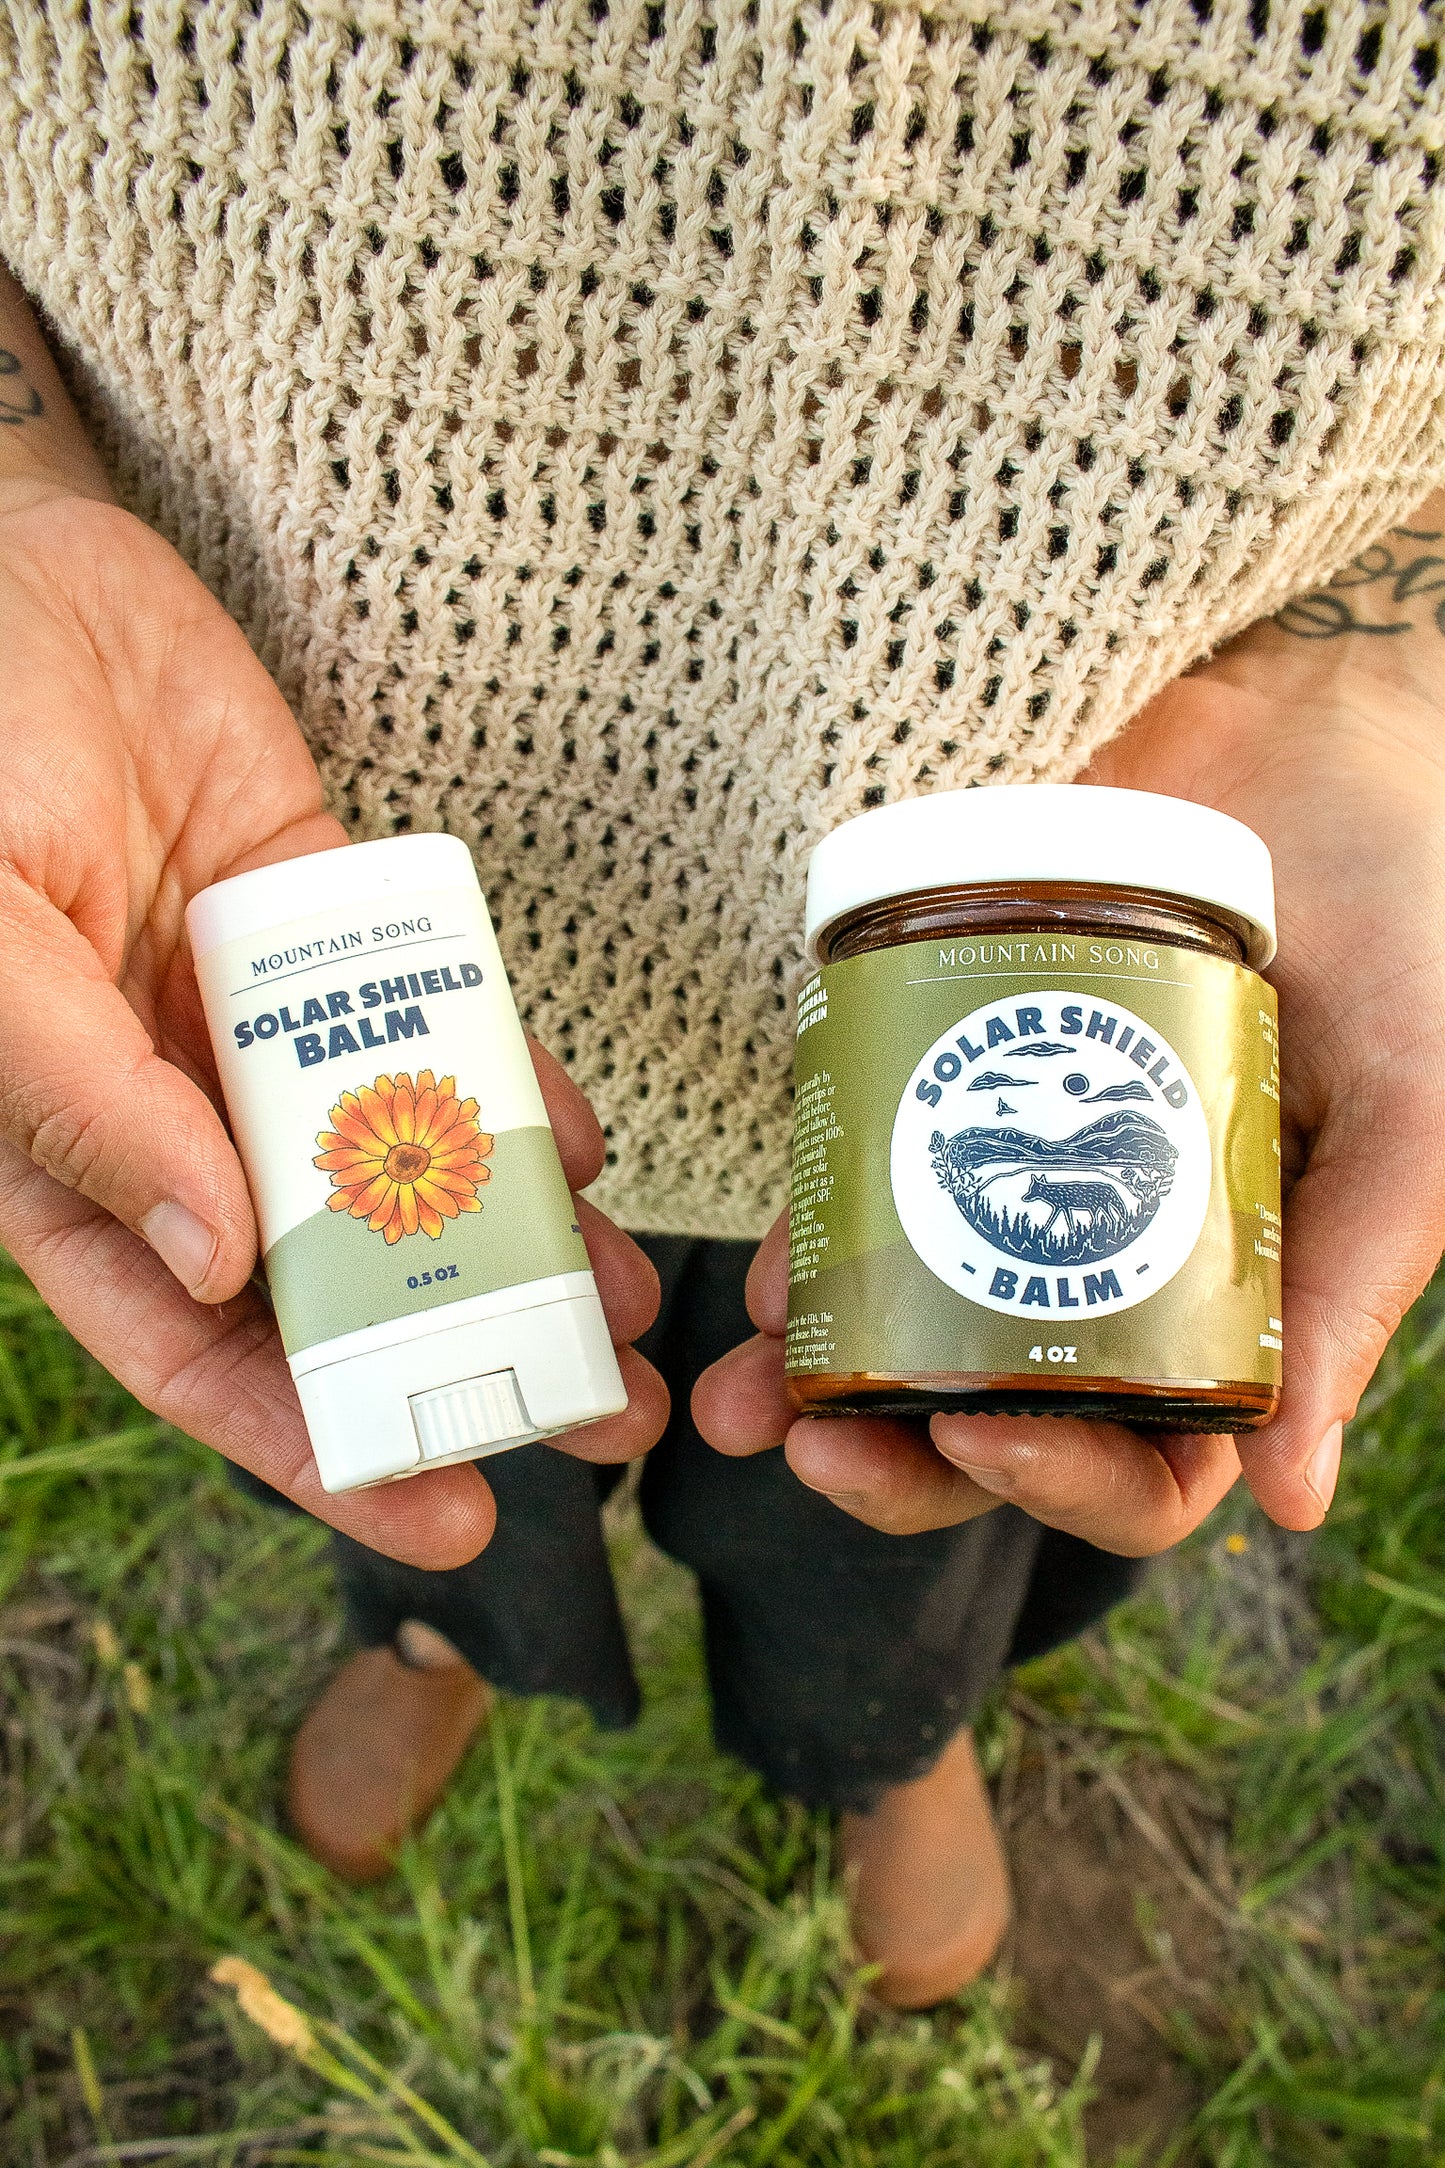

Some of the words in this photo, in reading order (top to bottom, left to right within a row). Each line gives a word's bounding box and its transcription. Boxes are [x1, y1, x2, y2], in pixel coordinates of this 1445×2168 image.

[251, 933, 364, 977] MOUNTAIN
[371, 917, 433, 942] SONG
[938, 943, 1077, 968] MOUNTAIN
[1088, 945, 1160, 970] SONG
[233, 990, 356, 1050] SOLAR
[358, 963, 484, 1010] SHIELD
[809, 1004, 828, 1028] SKIN
[293, 1005, 431, 1069] BALM
[915, 1006, 1048, 1109] SOLAR
[1060, 1005, 1189, 1110] SHIELD
[822, 1070, 832, 1087] by
[827, 1085, 836, 1096] or
[810, 1102, 832, 1118] before
[810, 1116, 829, 1132] tallow
[829, 1112, 836, 1125] &
[810, 1133, 825, 1146] uses
[825, 1125, 845, 1141] 100%
[812, 1159, 829, 1175] solar
[810, 1177, 819, 1190] act
[820, 1177, 828, 1187] as
[829, 1175, 835, 1185] a
[816, 1187, 833, 1203] SPF.
[813, 1220, 825, 1234] (no
[809, 1239, 817, 1250] as
[817, 1237, 830, 1252] any
[812, 1252, 820, 1264] to
[407, 1271, 433, 1290] 0.5
[434, 1264, 460, 1281] OZ
[809, 1269, 818, 1279] or
[988, 1267, 1124, 1308] BALM
[820, 1312, 833, 1324] This
[811, 1326, 829, 1339] Please
[804, 1341, 827, 1357] pregnant
[828, 1342, 836, 1351] or
[1028, 1345, 1043, 1362] 4
[1046, 1345, 1078, 1363] OZ
[812, 1354, 831, 1366] herbs.
